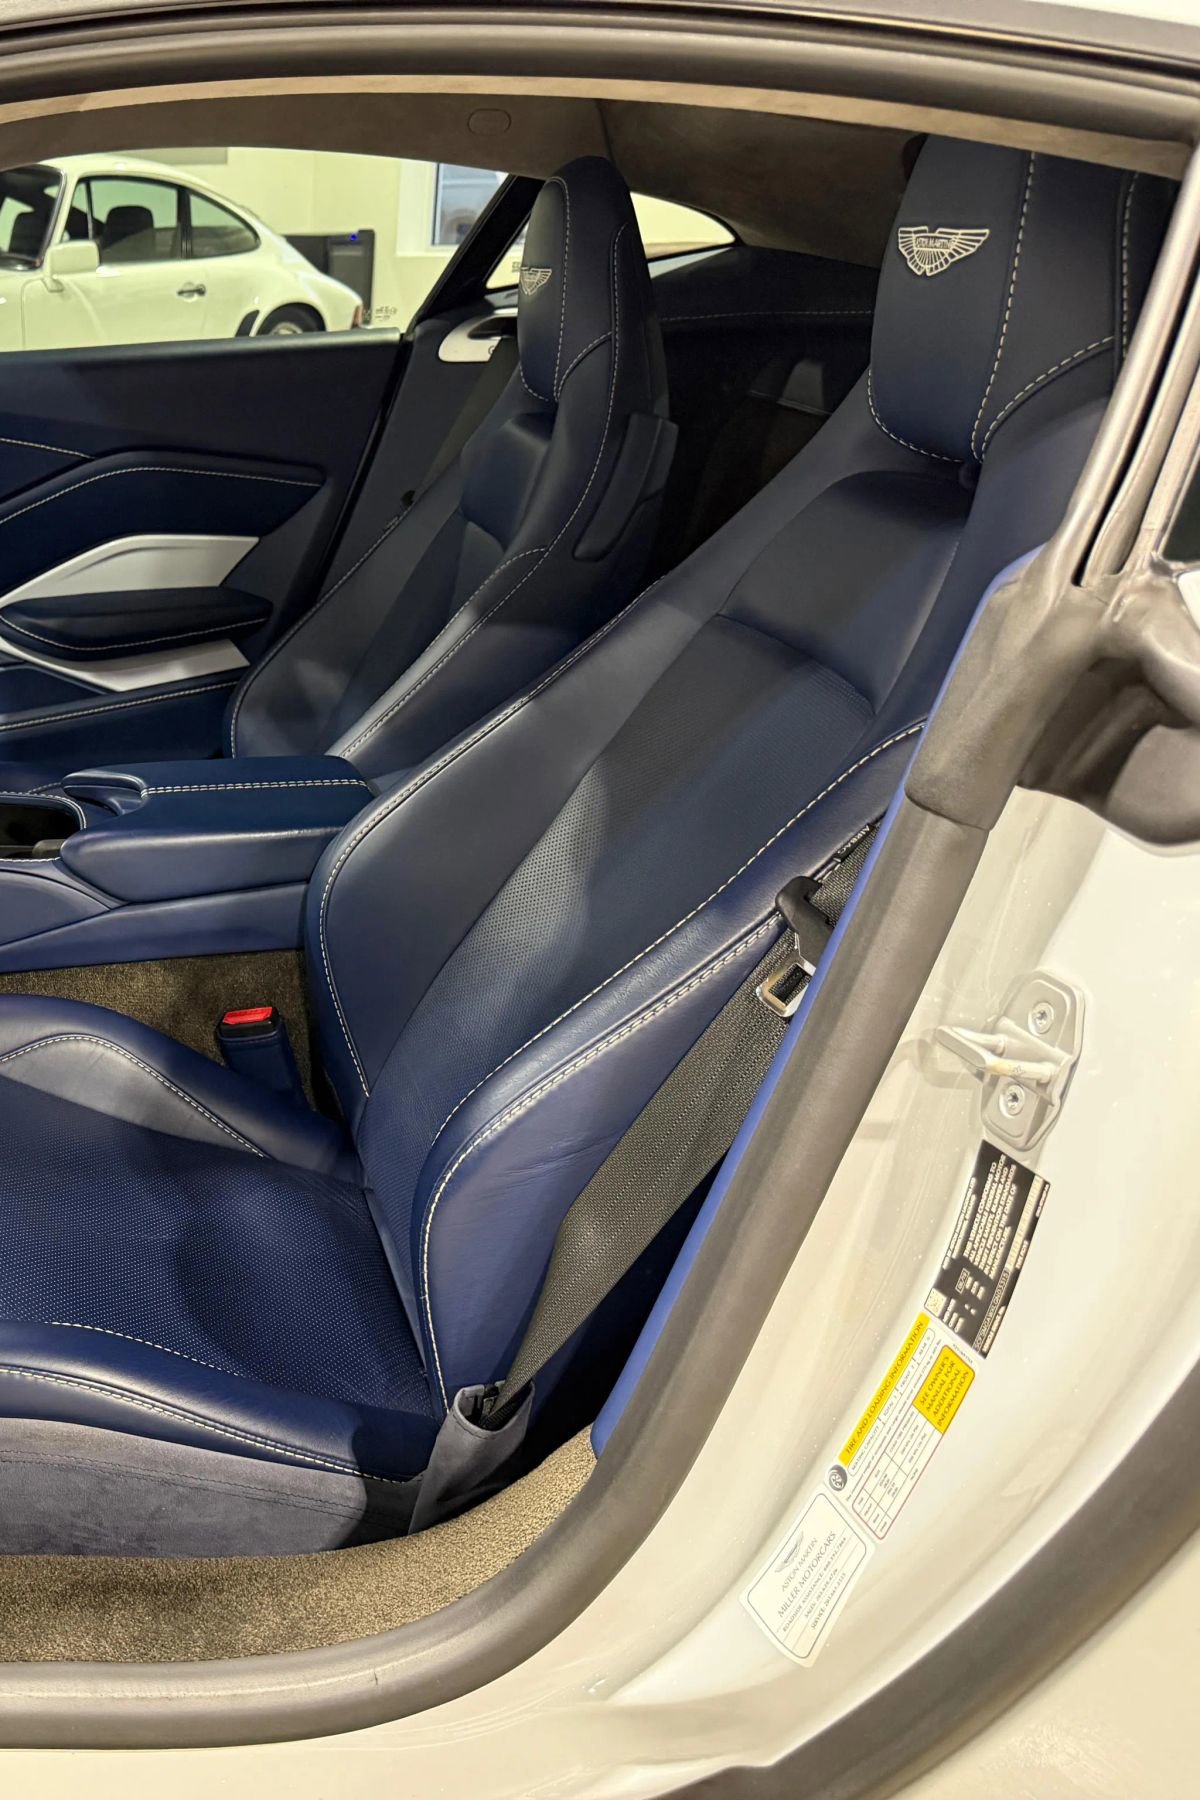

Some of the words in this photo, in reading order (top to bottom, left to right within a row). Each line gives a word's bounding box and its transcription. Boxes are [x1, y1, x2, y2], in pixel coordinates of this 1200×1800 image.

[988, 1160, 997, 1174] TO
[992, 1152, 1007, 1183] MOTOR
[997, 1162, 1018, 1206] STANDARDS
[972, 1237, 987, 1267] VEHICLE
[998, 1165, 1009, 1184] AND
[975, 1171, 996, 1215] CONFORMS
[983, 1180, 999, 1212] FEDERAL
[962, 1239, 973, 1259] THIS
[967, 1211, 982, 1242] VEHICLE
[970, 1209, 990, 1251] APPLICABLE
[982, 1263, 990, 1275] IN
[993, 1226, 1003, 1242] ON
[1002, 1193, 1014, 1214] DATE
[967, 1248, 976, 1263] ALL
[844, 1436, 857, 1454] TIRE
[854, 1416, 869, 1438] AND
[865, 1378, 891, 1418] LOADING
[887, 1320, 924, 1379] INFORMATION
[918, 1391, 929, 1406] SEE
[926, 1354, 950, 1392] OWNER'S
[924, 1377, 946, 1412] MANUAL
[942, 1359, 956, 1378] FOR
[930, 1367, 962, 1417] ADDITIONAL
[935, 1369, 970, 1426] INFORMATION
[776, 1583, 801, 1619] MILLER
[796, 1528, 837, 1589] MOTORCARS
[779, 1564, 800, 1593] ASTON
[796, 1535, 819, 1568] MARTIN
